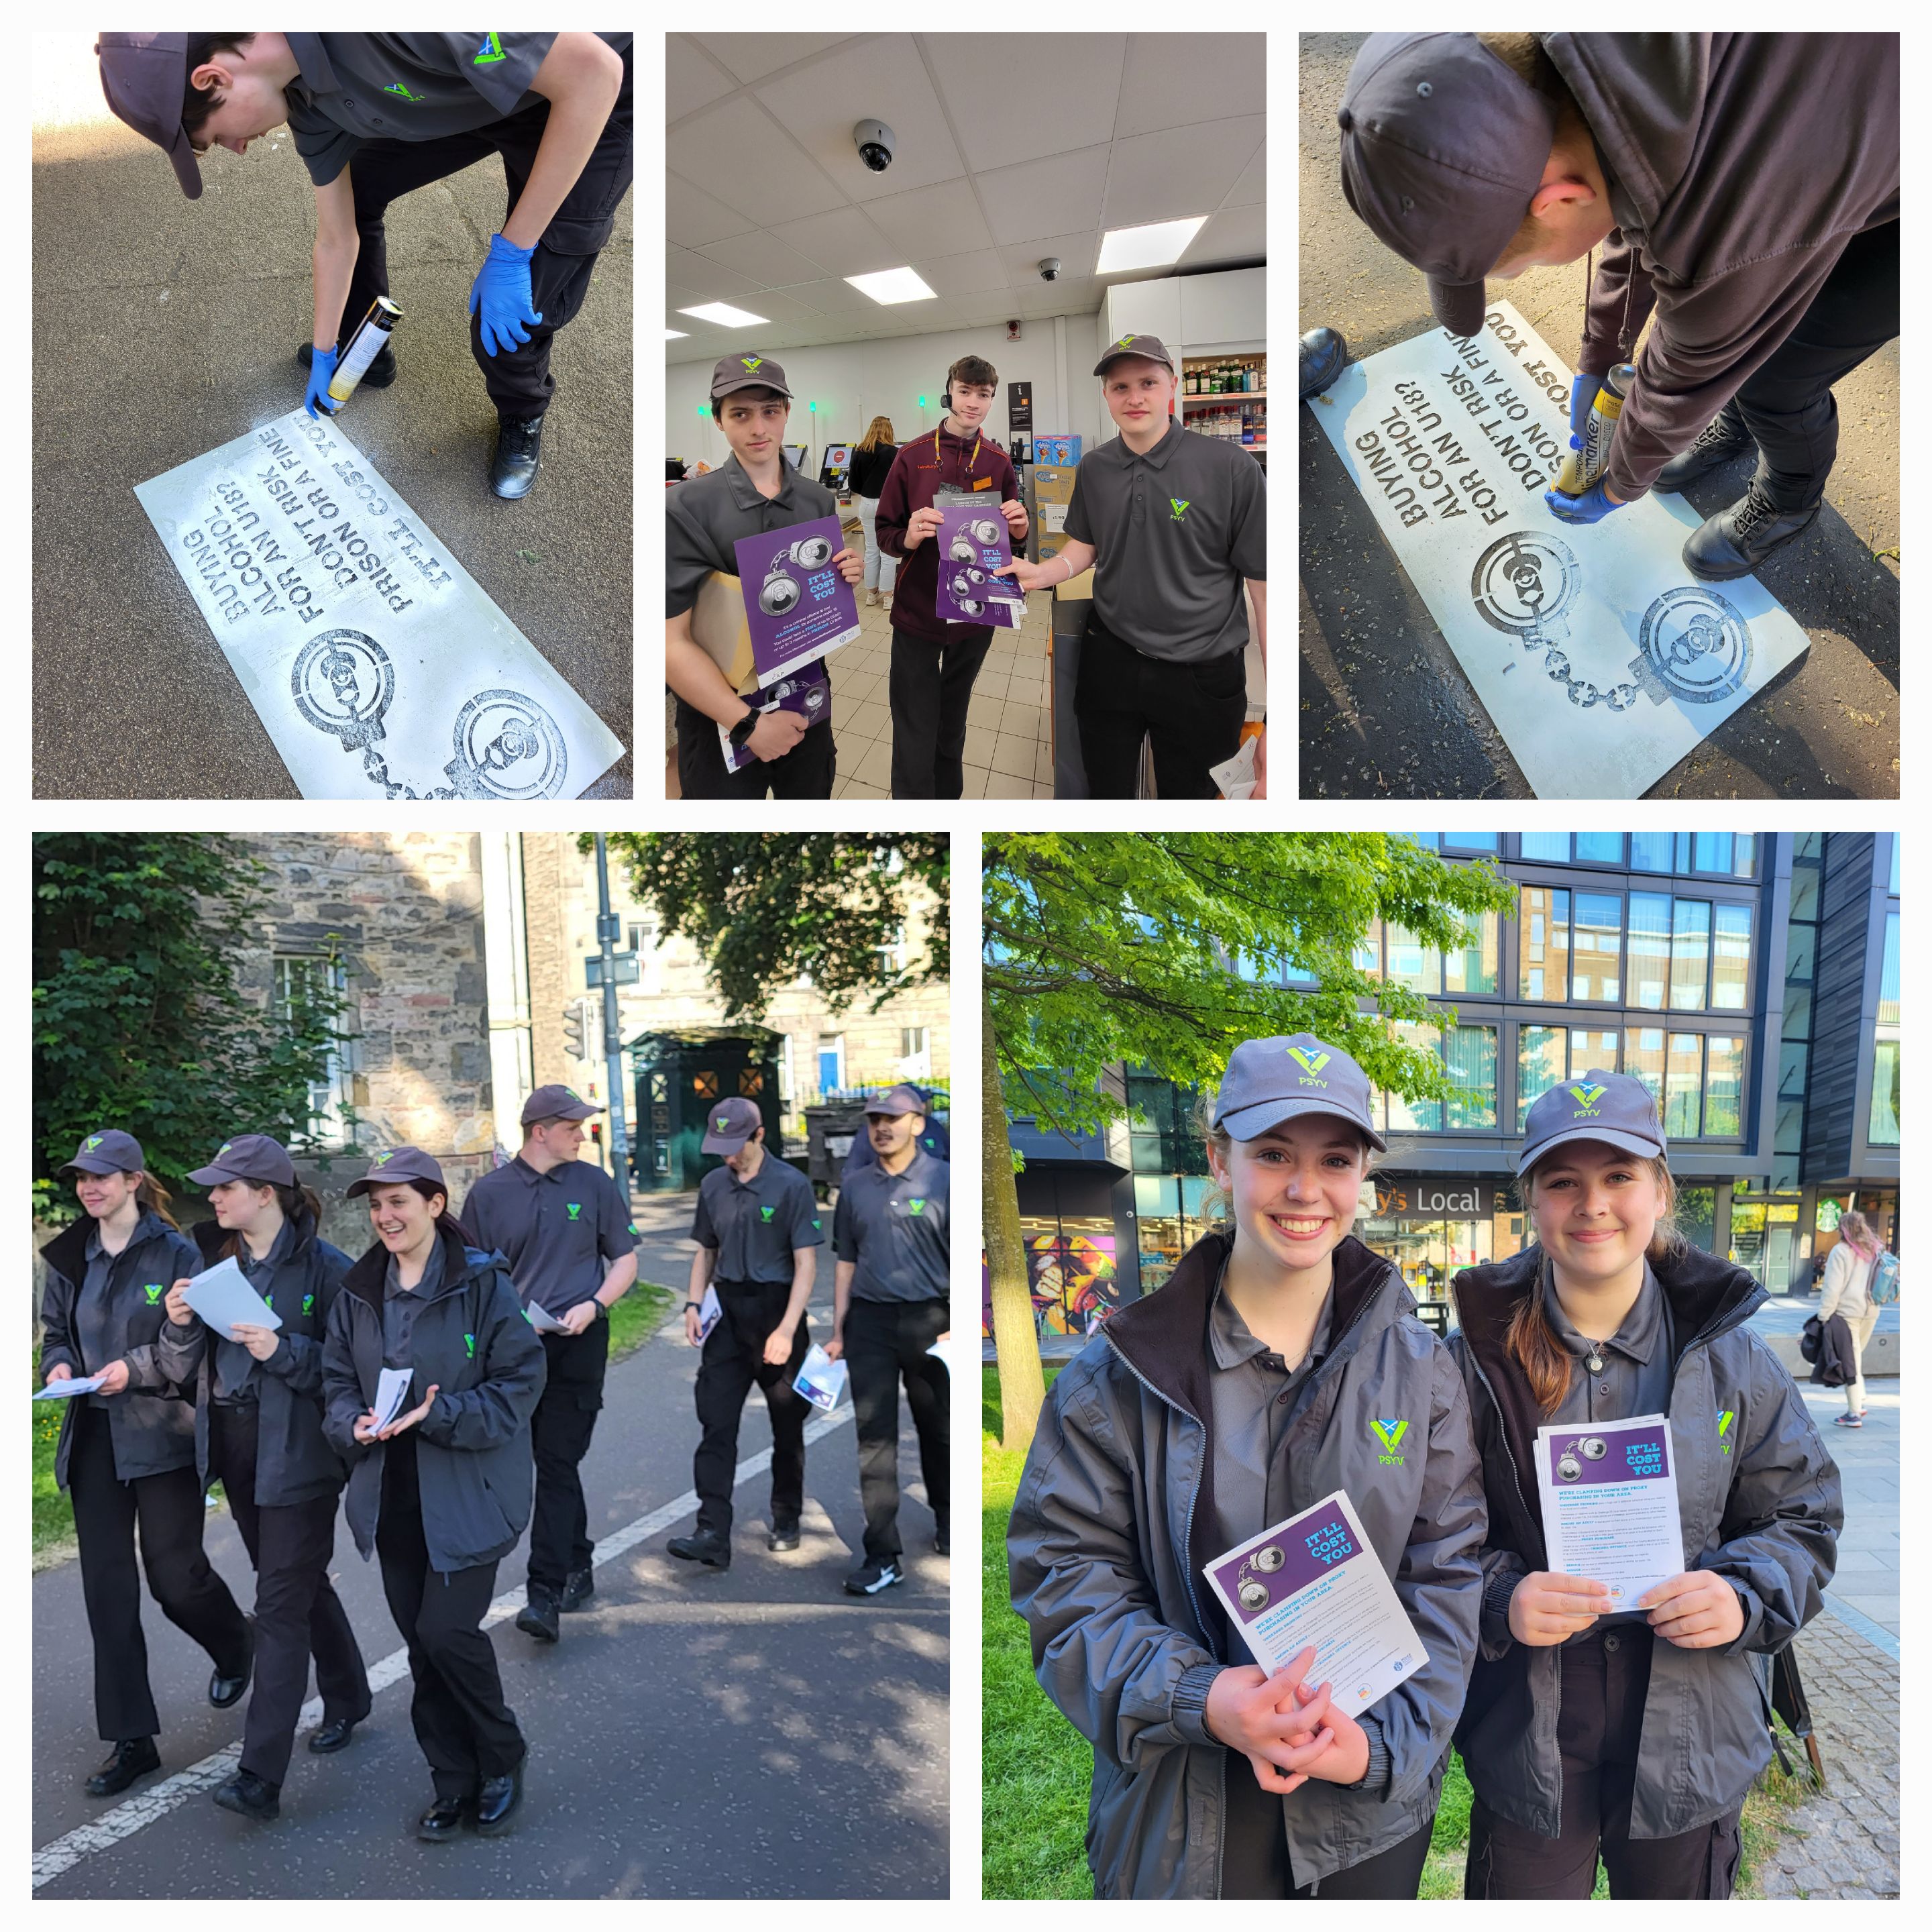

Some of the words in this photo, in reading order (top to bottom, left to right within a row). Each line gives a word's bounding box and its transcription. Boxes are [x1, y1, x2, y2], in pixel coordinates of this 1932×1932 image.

[1485, 313, 1529, 358] YOU
[1440, 364, 1491, 417] RISK
[1481, 369, 1505, 385] A
[1394, 380, 1442, 433] U18?
[1495, 387, 1529, 421] OR
[258, 428, 301, 471] FINE
[292, 415, 337, 458] YOU
[1432, 431, 1471, 466] AN
[1380, 406, 1468, 519] ALCOHOL
[1479, 419, 1548, 492] DON'T
[1575, 445, 1585, 484] TEMPORA
[256, 465, 304, 515] RISK
[294, 470, 316, 485] A
[331, 460, 388, 515] COST
[1355, 430, 1428, 529] BUYING
[216, 481, 260, 531] U18?
[307, 487, 339, 520] OR
[1459, 468, 1509, 526] FOR
[205, 505, 286, 615] ALCOHOL
[251, 530, 287, 563] AN
[293, 518, 358, 589] DON'T
[388, 518, 452, 590] IT'LL
[183, 529, 251, 625] BUYING
[332, 521, 413, 614] PRISON
[808, 570, 834, 585] IT'LL
[810, 578, 835, 593] COST
[276, 566, 324, 624] FOR
[814, 587, 835, 601] YOU
[775, 625, 801, 639] ALCOHOL
[806, 614, 823, 625] someone
[793, 635, 807, 643] months
[1299, 1077, 1328, 1088] PSYV
[1573, 1109, 1601, 1118] PSYV
[1417, 1187, 1481, 1212] Local
[1378, 1455, 1404, 1466] PSYV
[1626, 1443, 1660, 1455] IT'LL
[1626, 1454, 1660, 1465] COST
[1633, 1464, 1662, 1476] YOU
[1305, 1522, 1342, 1548] IT'LL
[1311, 1531, 1346, 1558] COST
[1321, 1542, 1352, 1564] YOU
[1273, 1598, 1301, 1618] CLAMPING
[1301, 1587, 1318, 1599] DOWN
[1319, 1581, 1328, 1589] ON
[1328, 1570, 1346, 1583] PROXY
[1258, 1611, 1293, 1635] PURCHASING
[1300, 1595, 1316, 1607] YOUR
